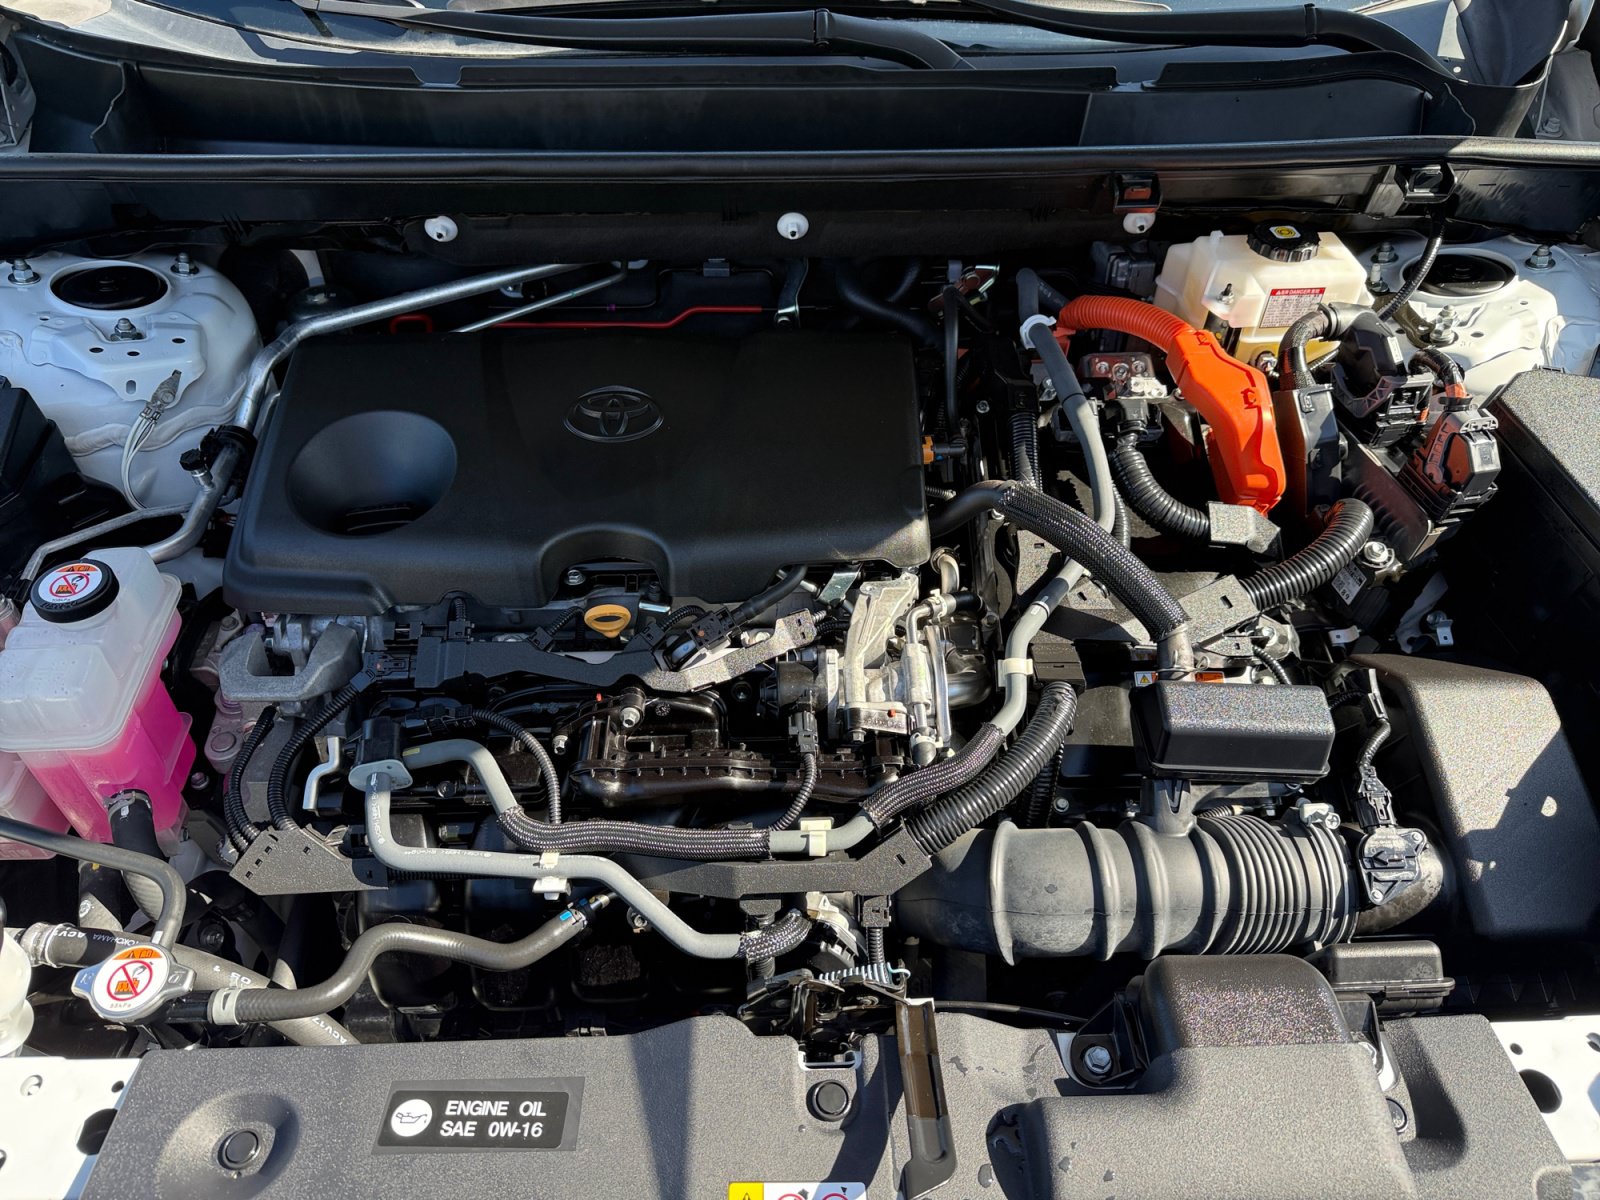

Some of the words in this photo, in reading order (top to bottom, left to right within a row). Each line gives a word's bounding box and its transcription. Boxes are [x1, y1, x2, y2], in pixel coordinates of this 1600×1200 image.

[311, 1017, 348, 1044] ACV17
[445, 1100, 509, 1116] ENGINE
[518, 1101, 547, 1117] OIL
[440, 1121, 477, 1137] SAE
[487, 1121, 543, 1138] 0W-16
